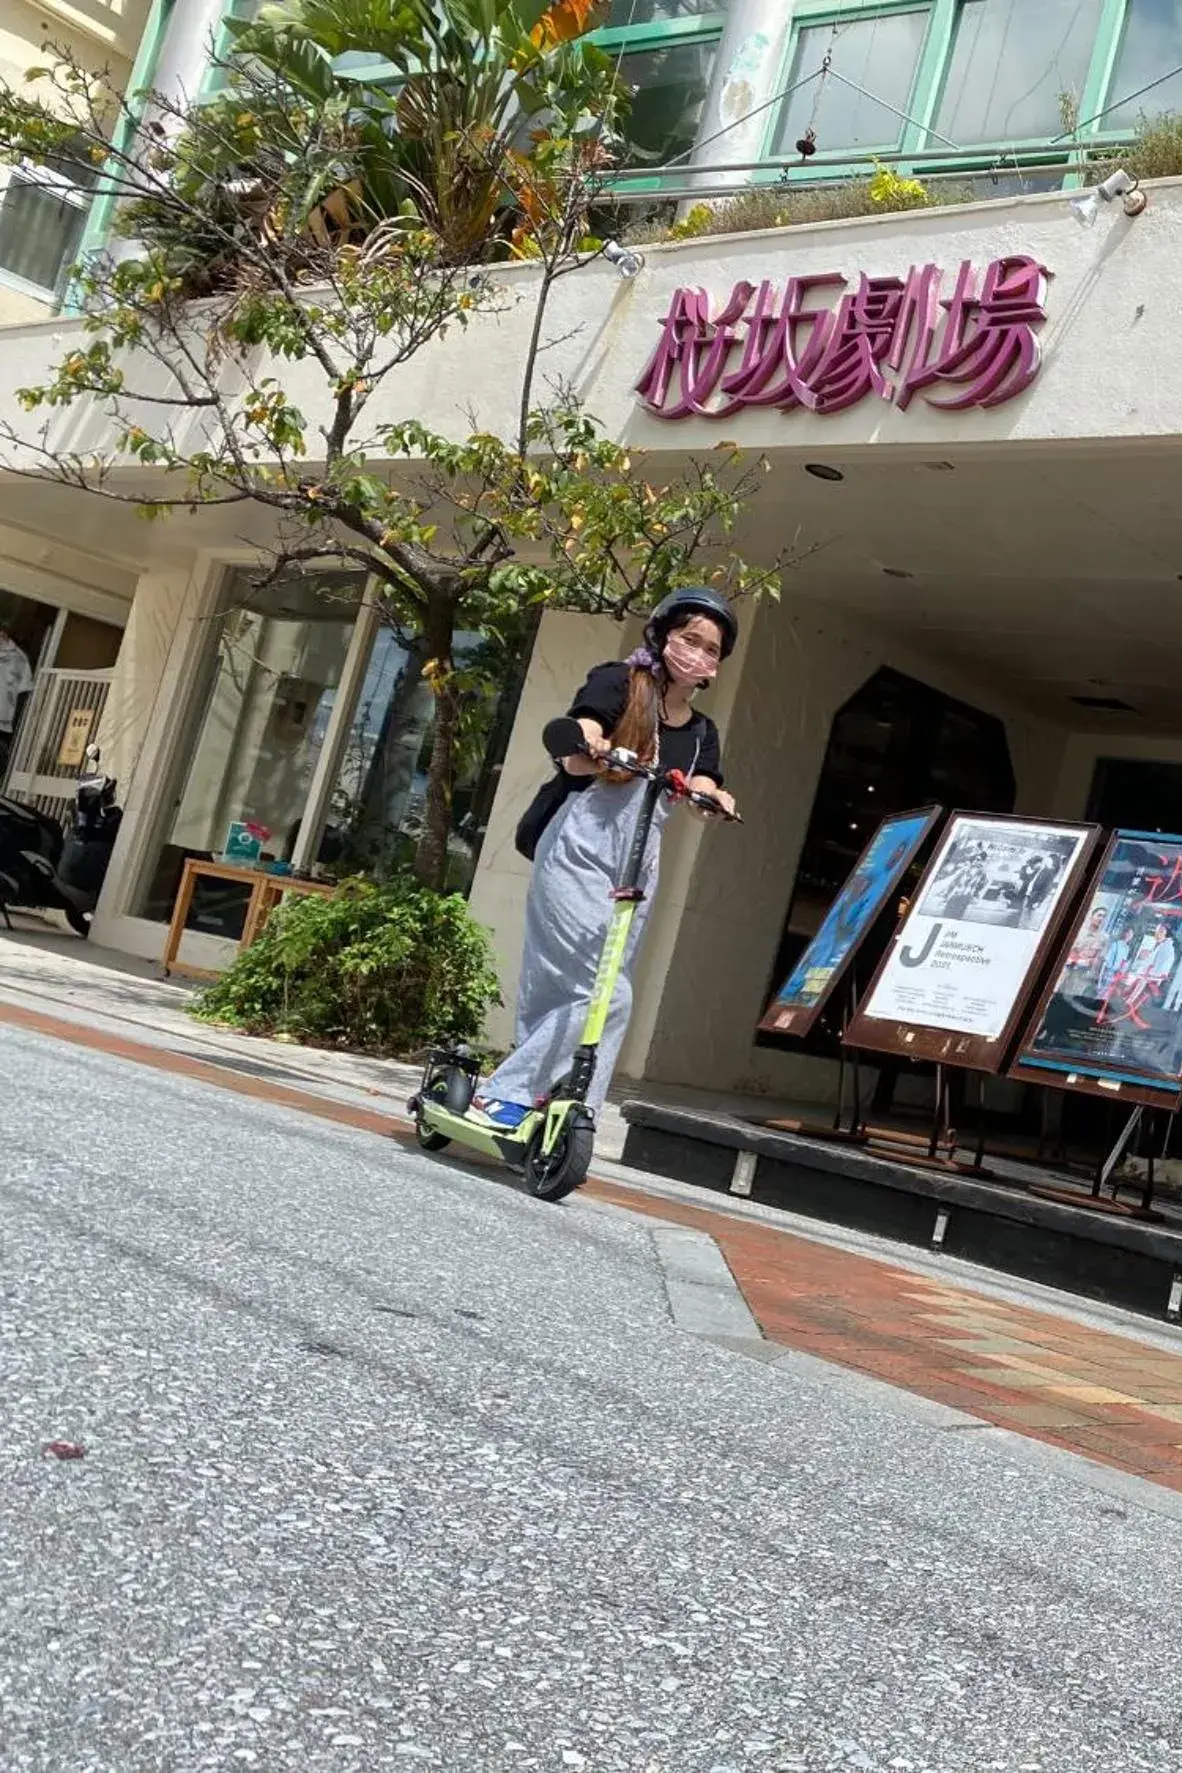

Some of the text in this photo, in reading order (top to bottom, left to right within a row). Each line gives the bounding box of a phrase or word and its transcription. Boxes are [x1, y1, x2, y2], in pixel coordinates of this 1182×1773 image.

[633, 254, 1056, 420] 桜坂劇場
[899, 923, 943, 968] J
